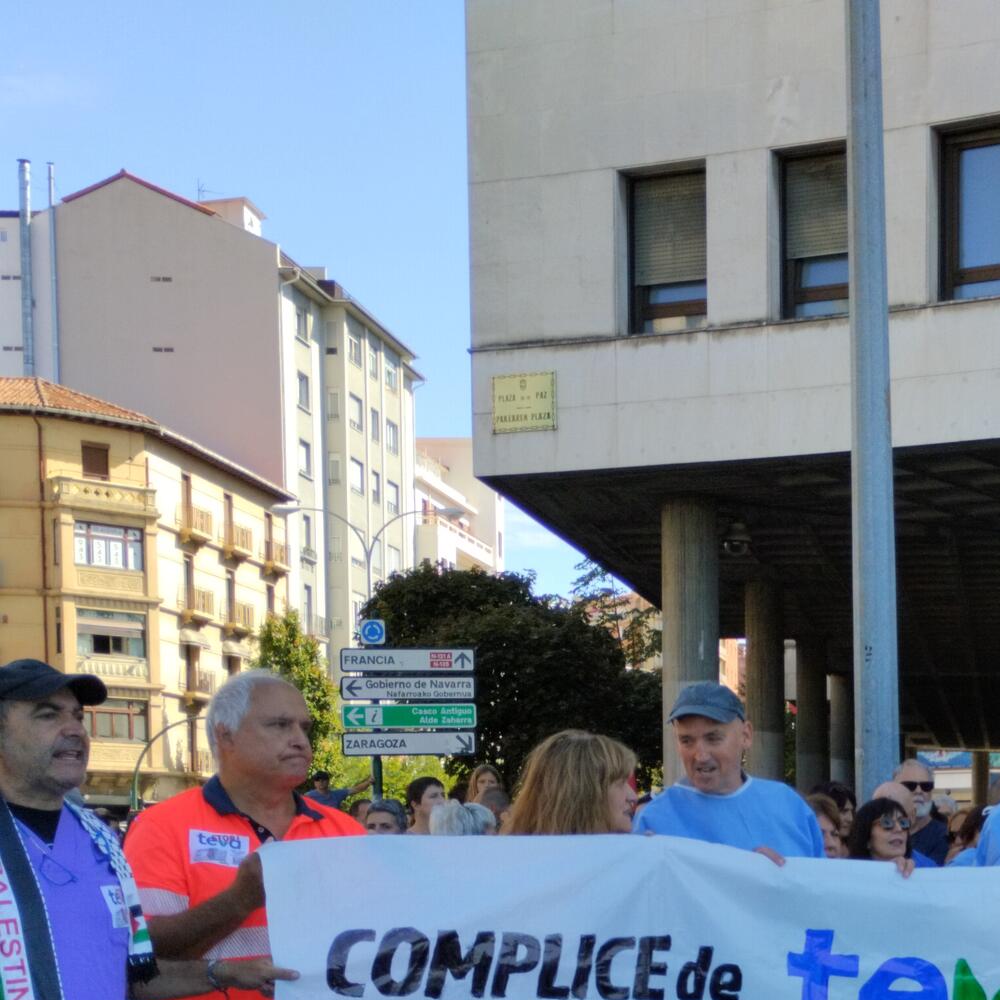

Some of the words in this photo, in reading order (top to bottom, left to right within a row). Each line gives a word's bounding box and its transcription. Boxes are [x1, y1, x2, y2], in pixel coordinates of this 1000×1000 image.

[536, 391, 547, 399] PAZ
[344, 655, 395, 665] FRANCIA
[366, 679, 412, 689] Gobierno
[414, 679, 427, 689] de
[430, 679, 472, 689] Navarra
[386, 690, 432, 698] Nafarroako
[433, 690, 472, 698] Gobernua
[411, 707, 438, 715] Casco
[441, 707, 473, 717] Antiguo
[419, 716, 438, 724] Alde
[441, 716, 473, 724] Zaharra
[346, 739, 407, 749] ZARAGOZA
[198, 832, 242, 850] teva
